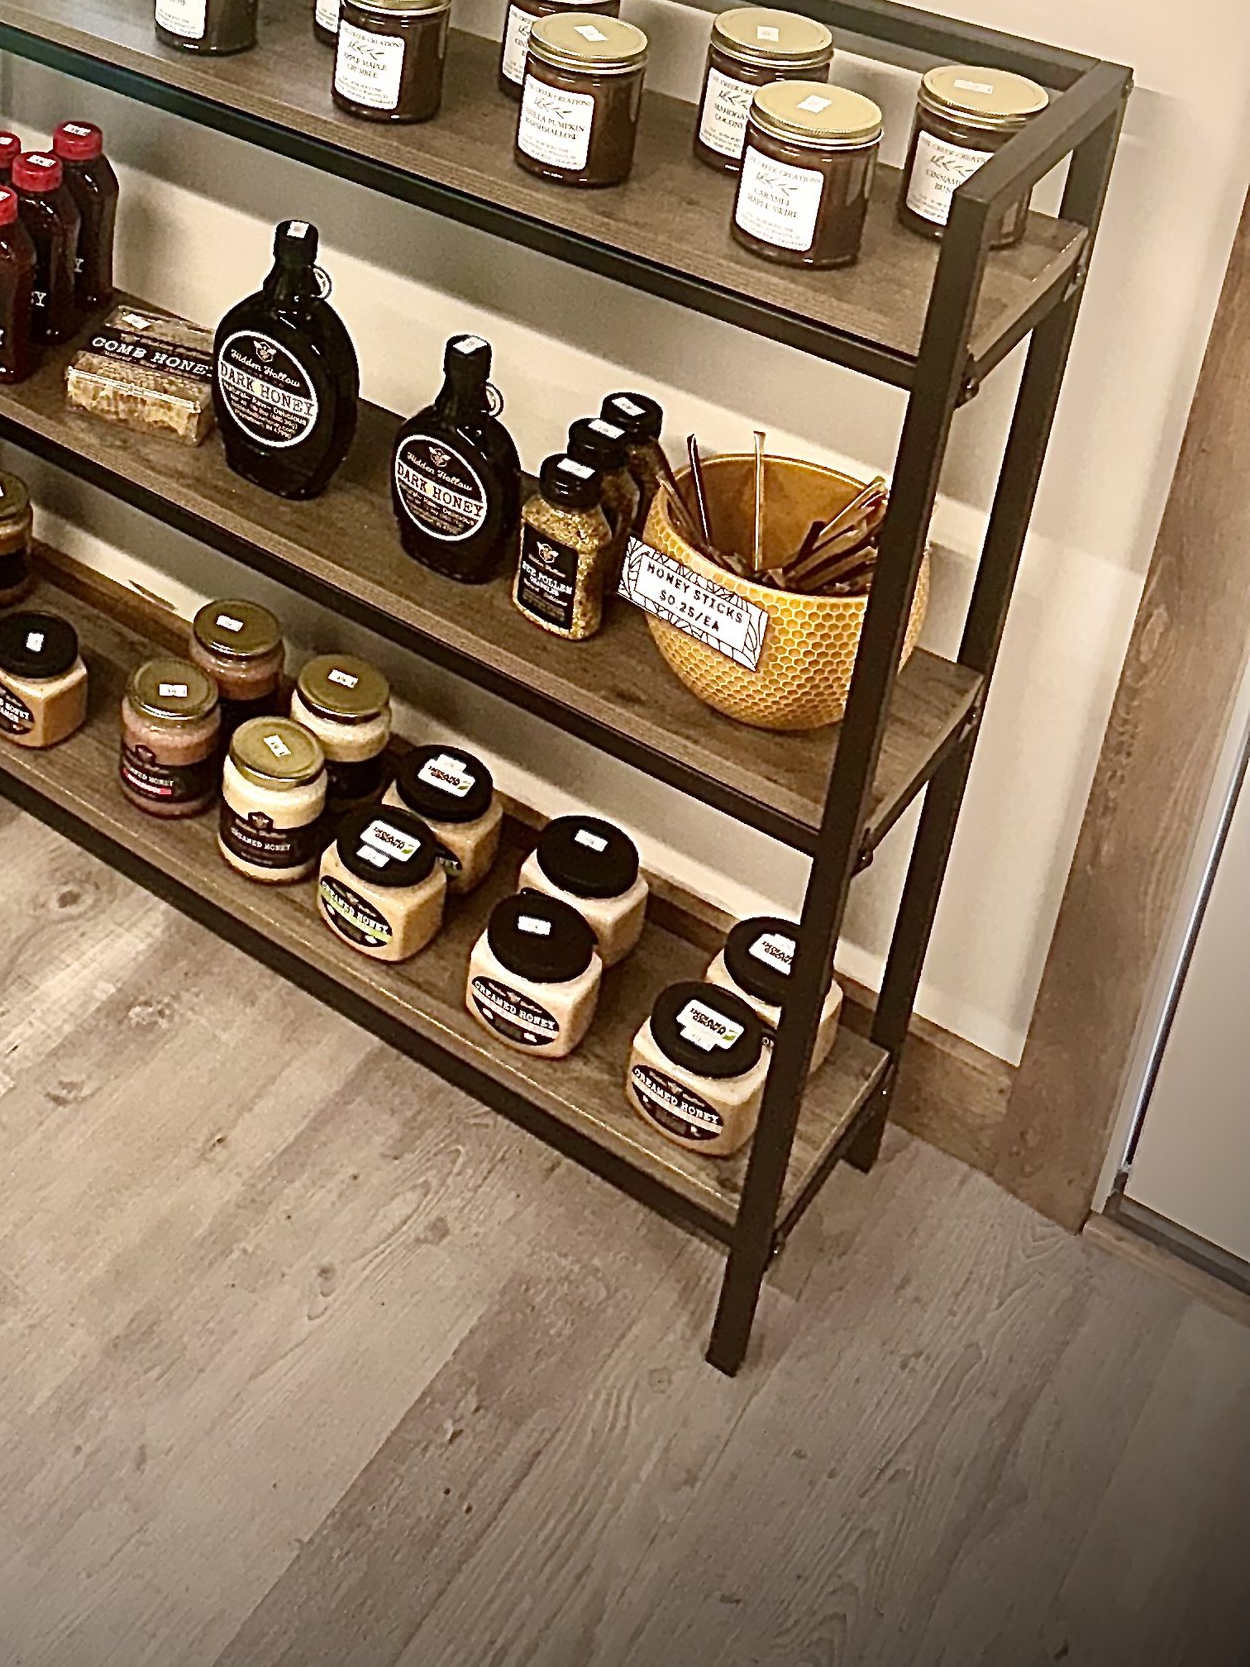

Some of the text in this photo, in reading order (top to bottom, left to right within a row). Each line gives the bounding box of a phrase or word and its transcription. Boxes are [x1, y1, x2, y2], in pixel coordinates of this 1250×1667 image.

[362, 59, 387, 71] MAPLE
[547, 118, 586, 133] PUMPKIN
[746, 195, 769, 210] MAPLE
[753, 187, 791, 206] CARAMEL
[91, 336, 148, 359] COMB
[230, 348, 301, 388] Hidden Hollow
[220, 360, 256, 394] DARK
[259, 382, 315, 417] HONEY
[406, 450, 473, 491] Hidden Hollow
[397, 462, 428, 493] DARK
[432, 485, 485, 517] HONEY
[522, 560, 573, 595] BEE POLLEN
[646, 561, 743, 624] HONEY STICKS
[658, 588, 720, 632] $0.25/EA
[5, 701, 30, 720] HONEY
[356, 909, 389, 934] HONEY
[474, 979, 556, 1030] CREAMED HONEY
[634, 1066, 720, 1125] CREAMED HONEY
